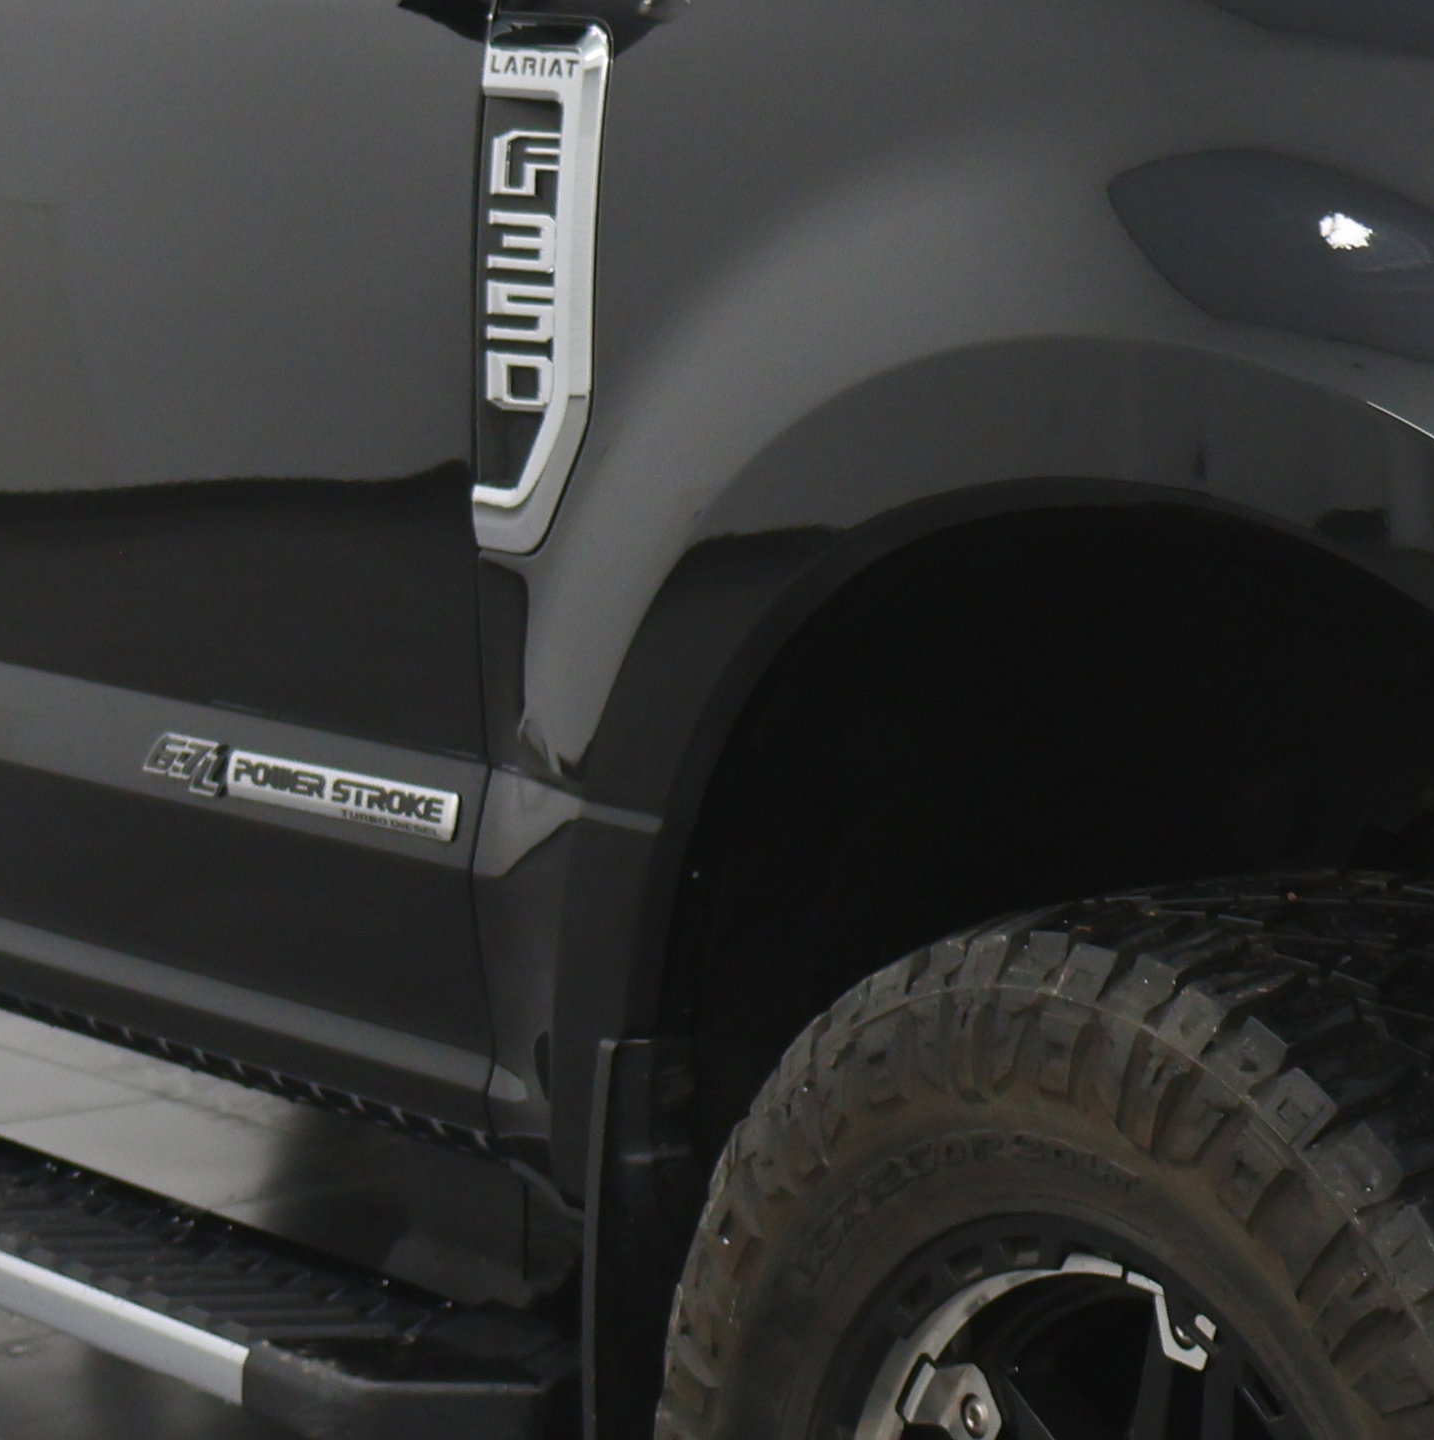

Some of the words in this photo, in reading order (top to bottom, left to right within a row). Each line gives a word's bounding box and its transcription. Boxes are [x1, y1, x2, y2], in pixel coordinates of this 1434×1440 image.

[490, 54, 580, 78] LARIAT
[233, 758, 326, 800] POWER
[331, 779, 444, 823] STROKE
